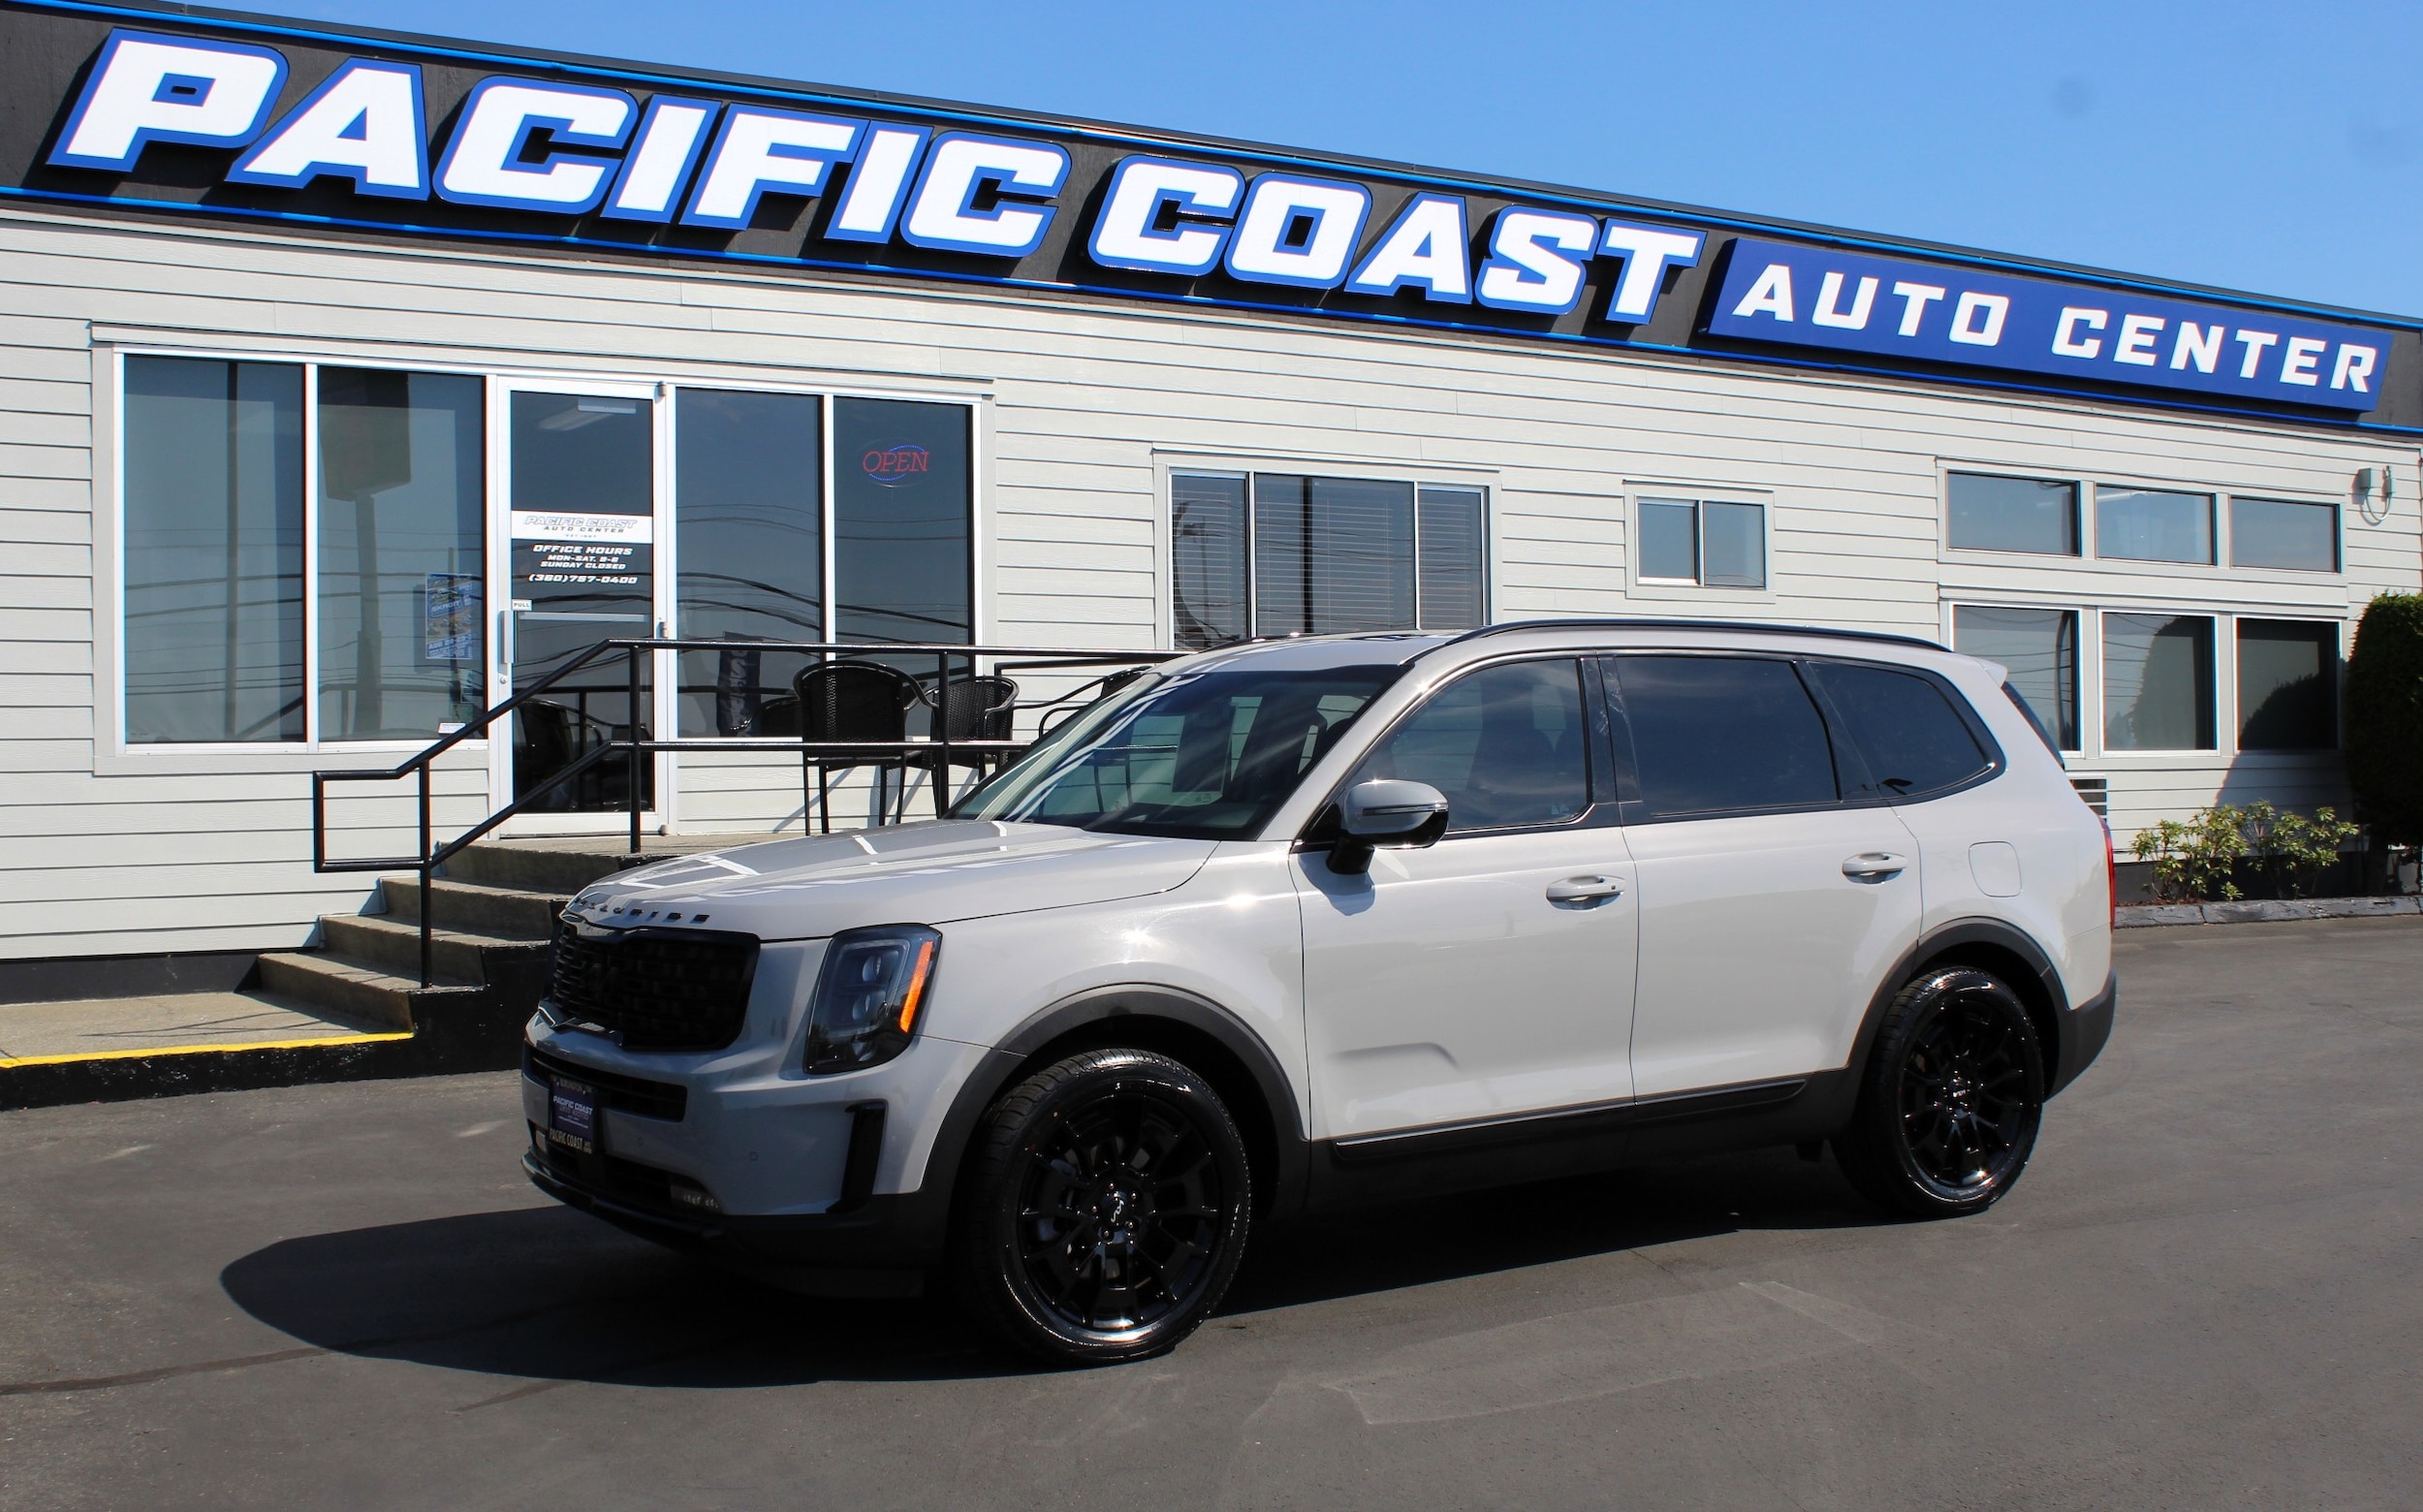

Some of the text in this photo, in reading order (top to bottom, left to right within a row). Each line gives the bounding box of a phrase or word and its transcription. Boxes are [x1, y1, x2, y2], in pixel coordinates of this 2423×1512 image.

[46, 27, 1709, 325] PACIFIC COAST
[1732, 264, 2376, 394] AUTO CENTER
[862, 451, 929, 472] OPEN
[524, 516, 637, 529] PACIFIC COAST
[532, 544, 633, 555] OFFICE HOURS
[540, 560, 626, 570] SUNDAY CLOSED
[552, 1095, 593, 1115] PACIFIC COAST
[550, 1127, 566, 1145] PACIFIC
[567, 1133, 583, 1150] COAST
